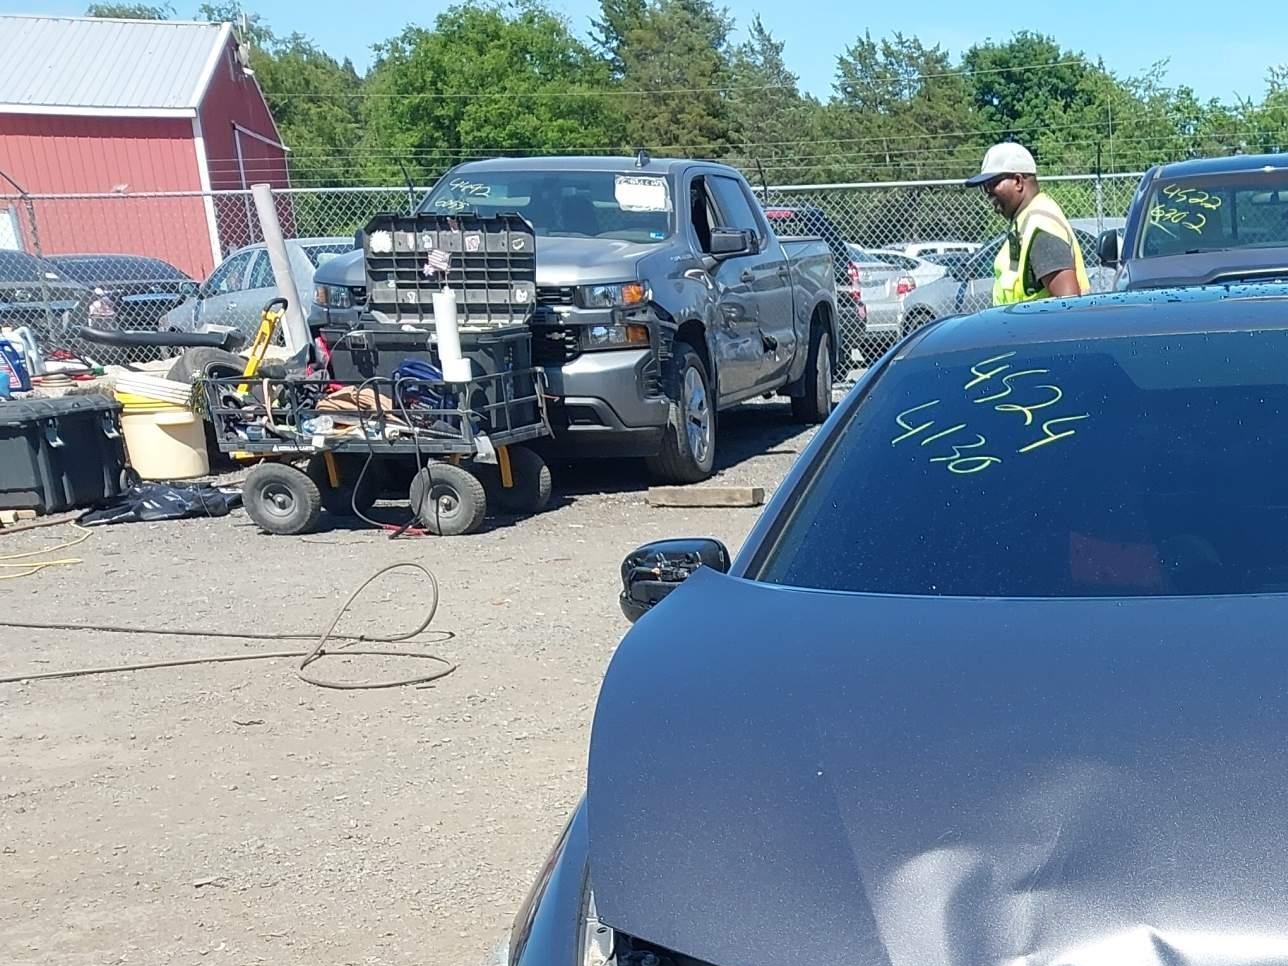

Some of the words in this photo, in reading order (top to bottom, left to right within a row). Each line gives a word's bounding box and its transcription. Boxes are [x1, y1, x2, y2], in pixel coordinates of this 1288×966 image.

[1163, 183, 1222, 210] 4522
[892, 399, 1002, 474] 4130
[964, 351, 1090, 453] 4524
